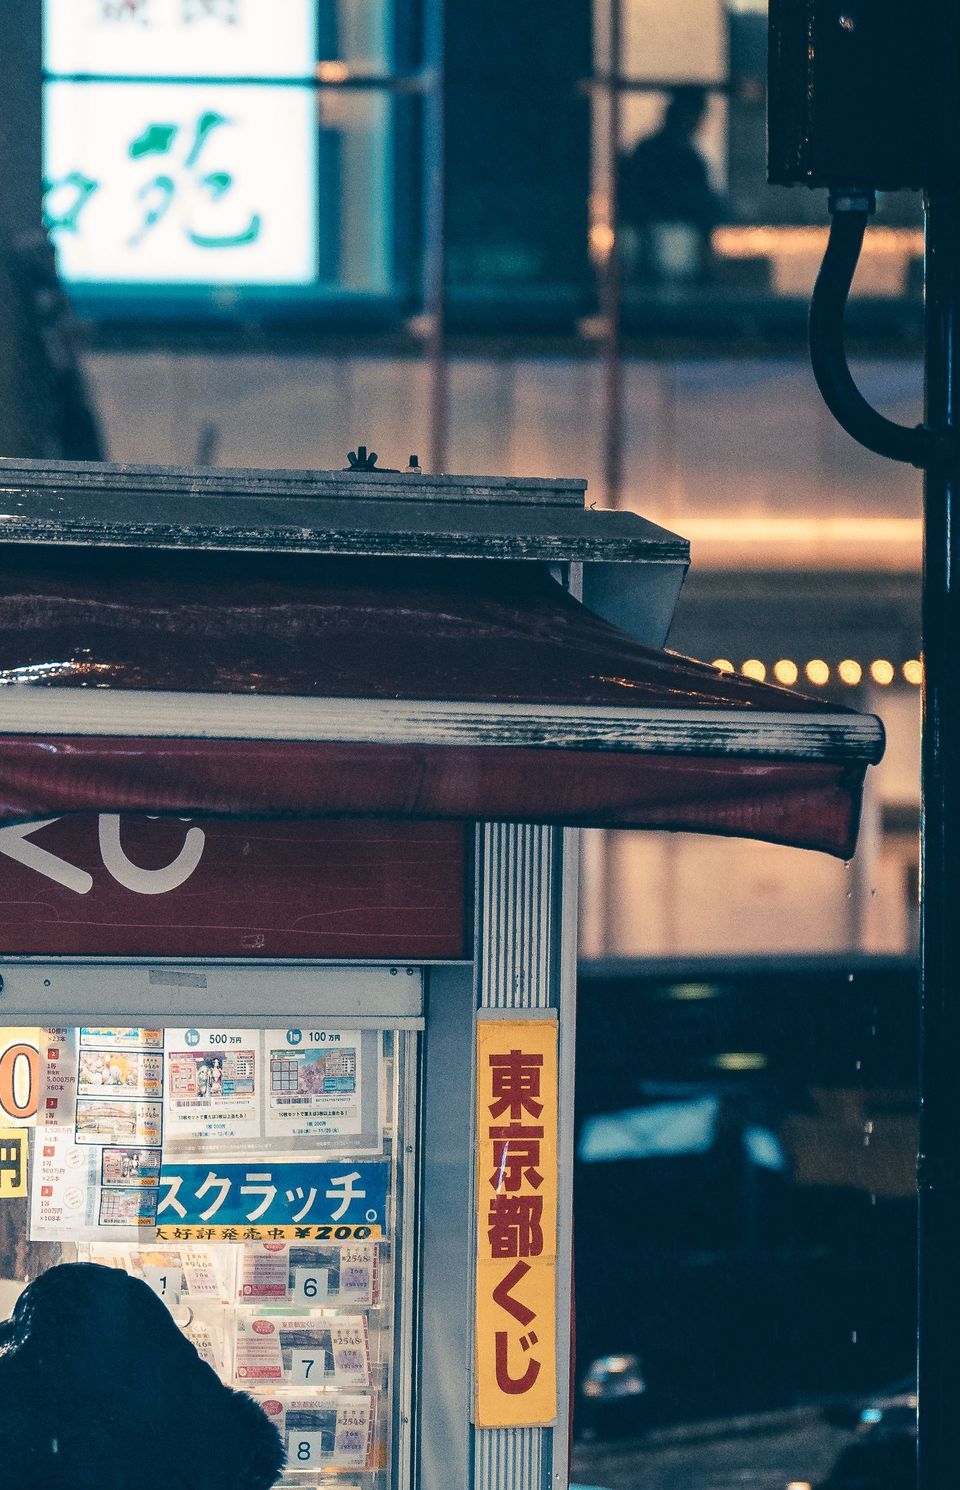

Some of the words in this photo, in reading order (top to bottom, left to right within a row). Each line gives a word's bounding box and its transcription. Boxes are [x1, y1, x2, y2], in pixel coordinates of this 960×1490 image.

[209, 1034, 227, 1044] 500
[309, 1031, 326, 1042] 100
[157, 1171, 378, 1222] スクラッチ。
[488, 1049, 545, 1396] 東京都くじ
[156, 1228, 286, 1241] 大好評発売中
[303, 1277, 318, 1297] 6
[301, 1359, 315, 1379] 7
[297, 1441, 312, 1461] 8
